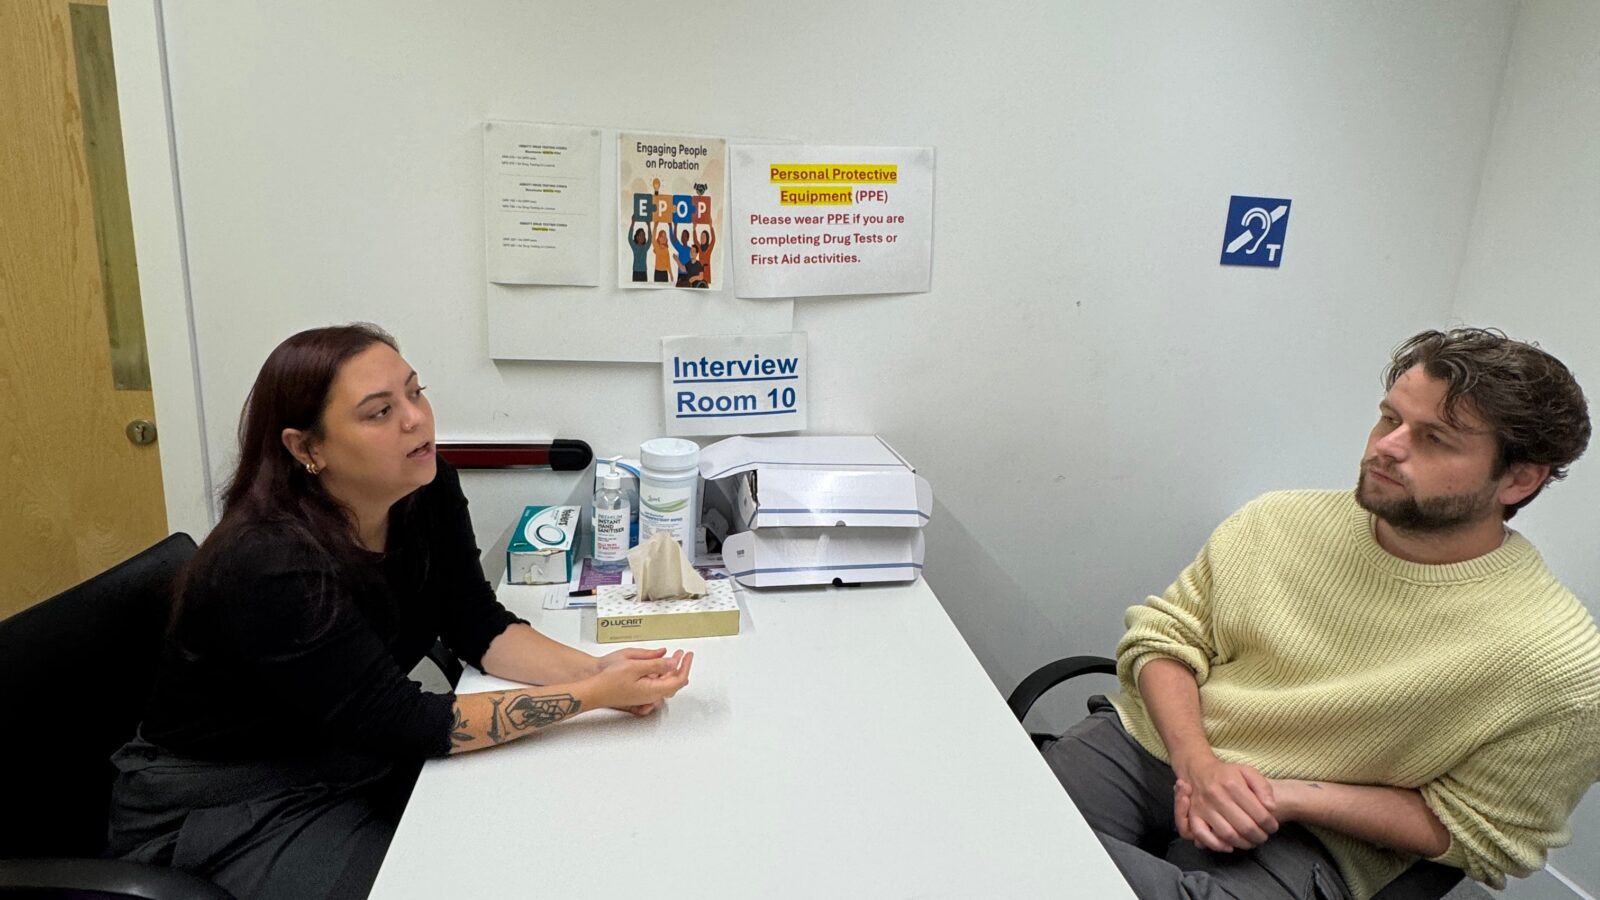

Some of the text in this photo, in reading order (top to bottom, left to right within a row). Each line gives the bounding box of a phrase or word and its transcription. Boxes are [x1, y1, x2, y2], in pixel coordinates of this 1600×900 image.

[636, 142, 708, 157] Engaging People
[646, 158, 699, 170] on Probation
[770, 168, 897, 180] Personal Protective
[780, 190, 888, 204] Equipment (PPE)
[750, 213, 904, 226] Please wear PPE if you are
[750, 233, 898, 247] completing Drug Tests or
[751, 253, 861, 265] First Aid activities.
[1266, 243, 1281, 261] T
[673, 354, 798, 378] Interview
[677, 387, 796, 412] Room 10
[610, 618, 642, 626] LUCART
